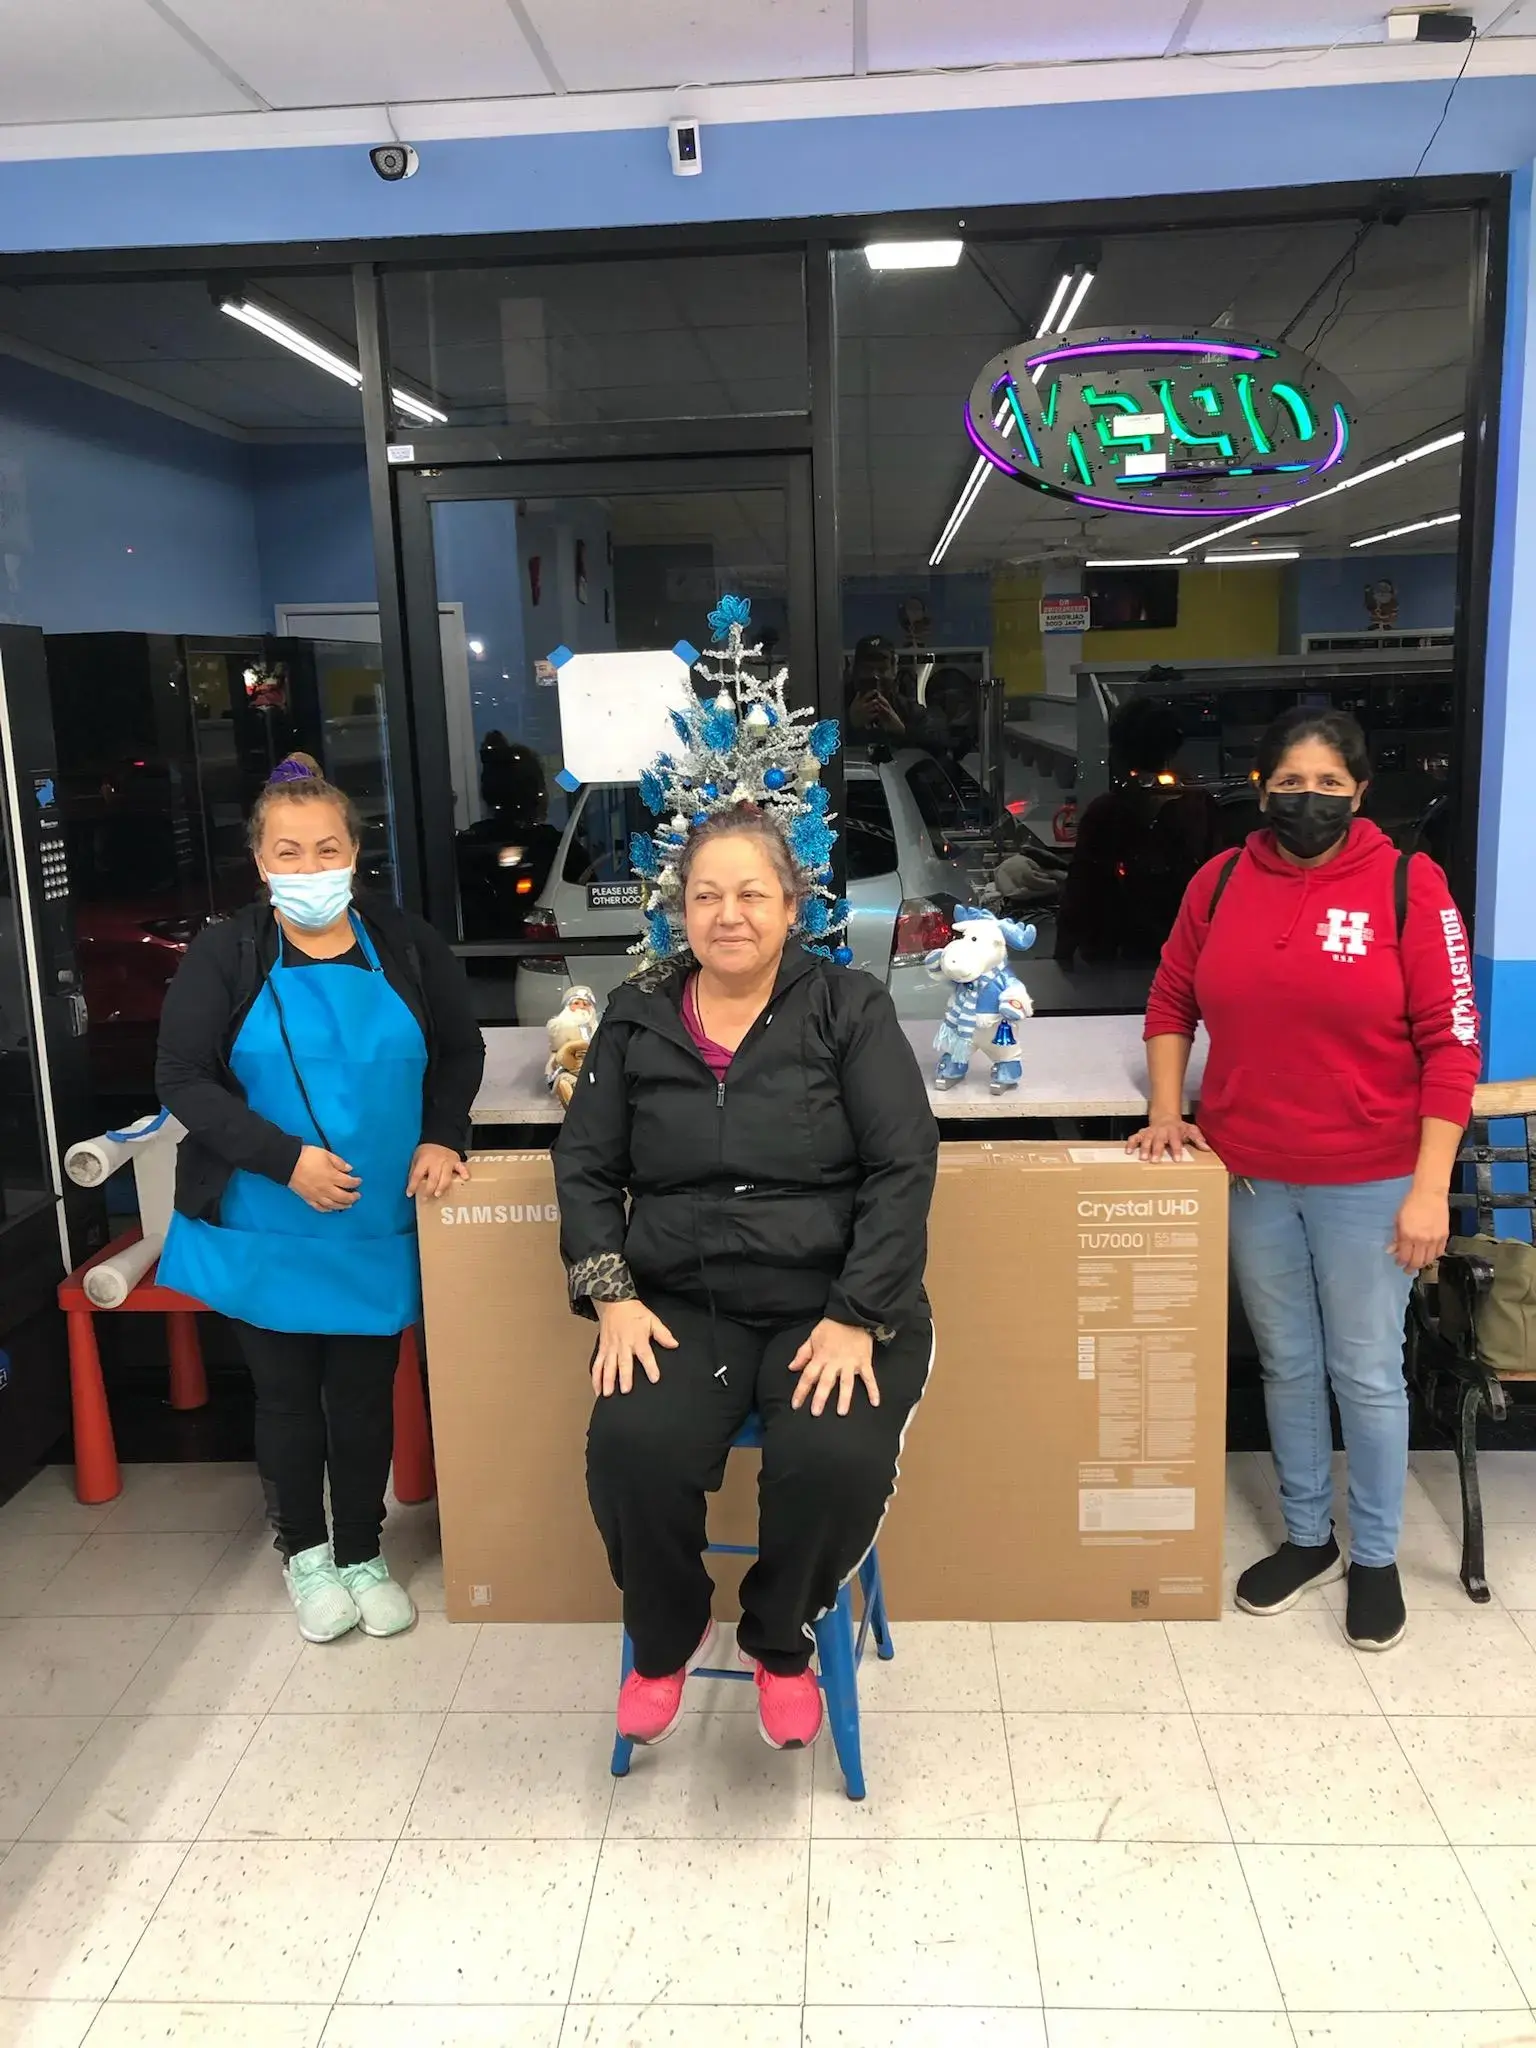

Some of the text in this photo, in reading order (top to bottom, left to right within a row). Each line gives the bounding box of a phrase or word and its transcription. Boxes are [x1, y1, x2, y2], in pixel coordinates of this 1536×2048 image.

[591, 886, 638, 896] PLEASE USE
[592, 895, 642, 905] OTHER DOO
[466, 1154, 552, 1162] AMSUN
[440, 1204, 558, 1225] SAMSUNG
[1077, 1199, 1199, 1221] Crystal UHD
[1077, 1232, 1144, 1249] TU7000
